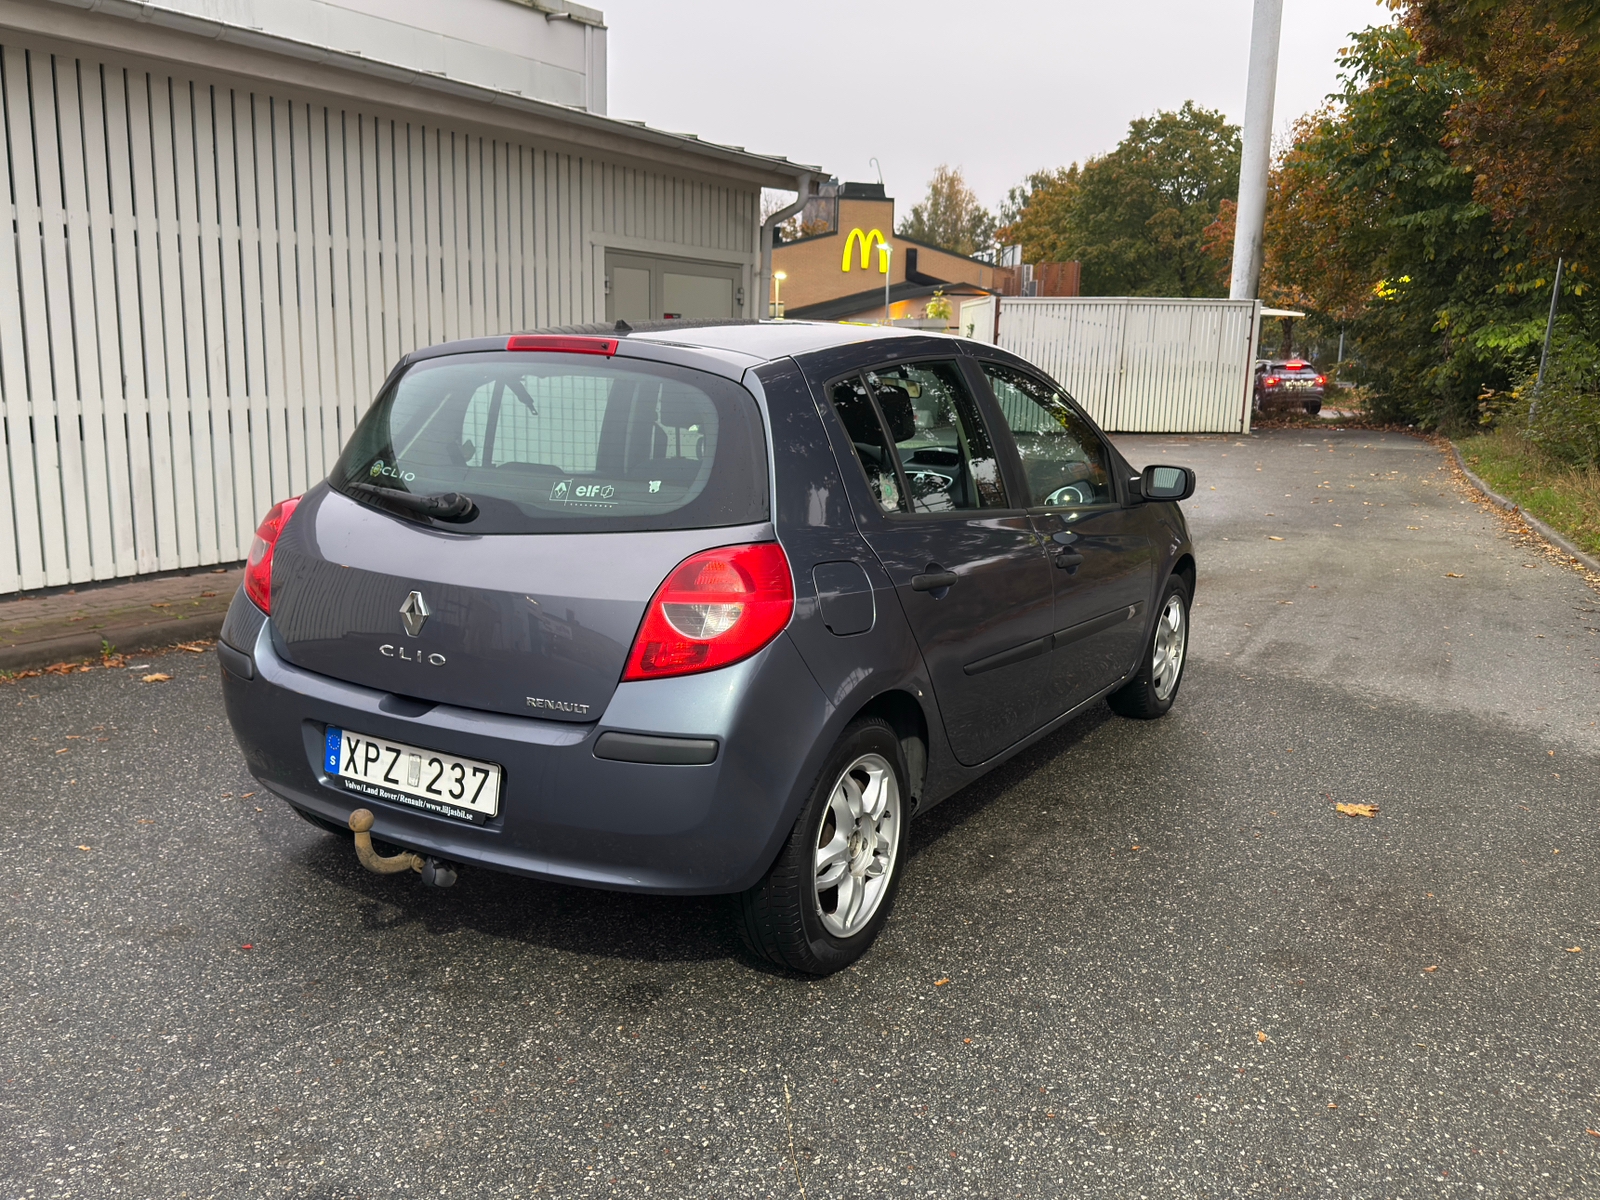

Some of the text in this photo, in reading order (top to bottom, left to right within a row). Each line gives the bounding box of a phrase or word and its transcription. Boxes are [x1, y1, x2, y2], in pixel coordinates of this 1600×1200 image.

[381, 466, 415, 481] CLIO
[575, 485, 600, 497] elf
[379, 644, 446, 666] CLIO
[526, 696, 590, 714] RENAULT
[329, 755, 337, 766] S
[344, 736, 490, 804] XPZ 237
